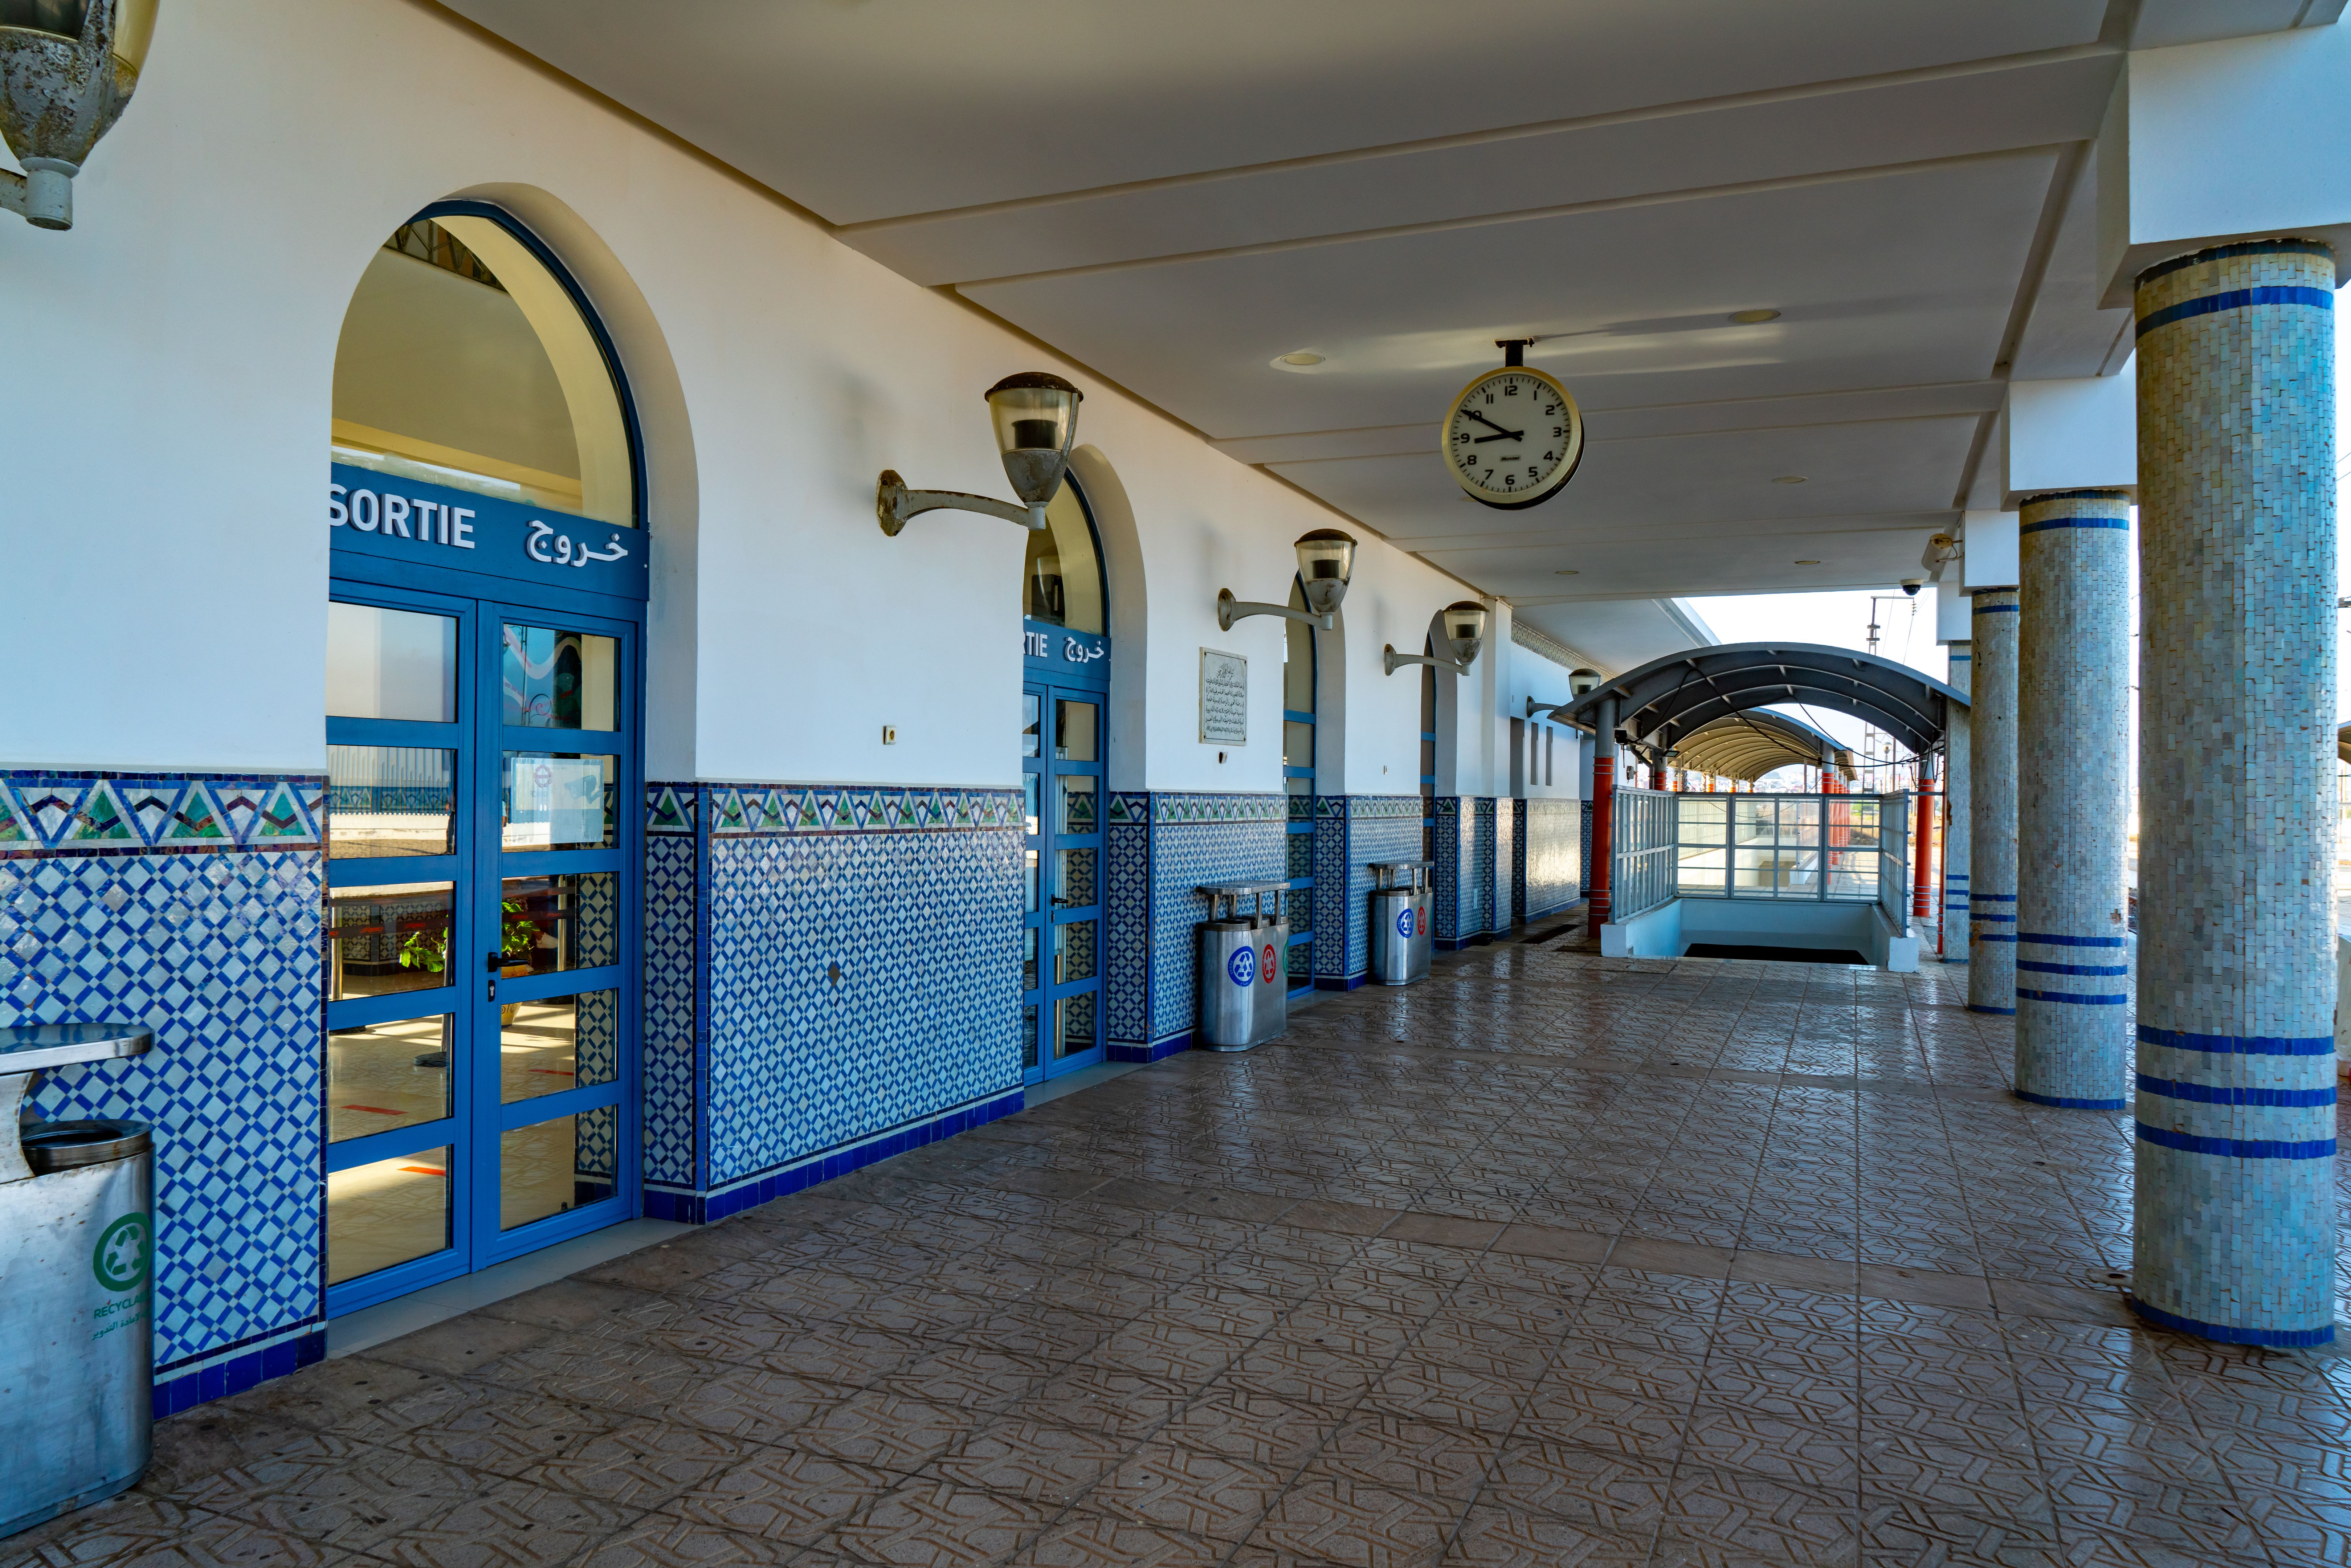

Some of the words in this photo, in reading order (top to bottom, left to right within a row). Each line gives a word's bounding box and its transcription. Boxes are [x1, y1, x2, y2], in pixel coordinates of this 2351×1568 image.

[1505, 385, 1518, 396] 12
[1534, 391, 1537, 400] 1
[1486, 394, 1494, 404] 11
[1546, 405, 1555, 415] 2
[1553, 427, 1562, 437] 3
[1461, 433, 1470, 443] 9
[1467, 455, 1477, 465] 8
[1543, 451, 1554, 461] 4
[1485, 469, 1494, 480] 7
[1528, 467, 1538, 477] 5
[1505, 475, 1515, 485] 6
[330, 483, 475, 549] SORTIE
[526, 520, 629, 568] خروج
[1065, 637, 1104, 663] خروج
